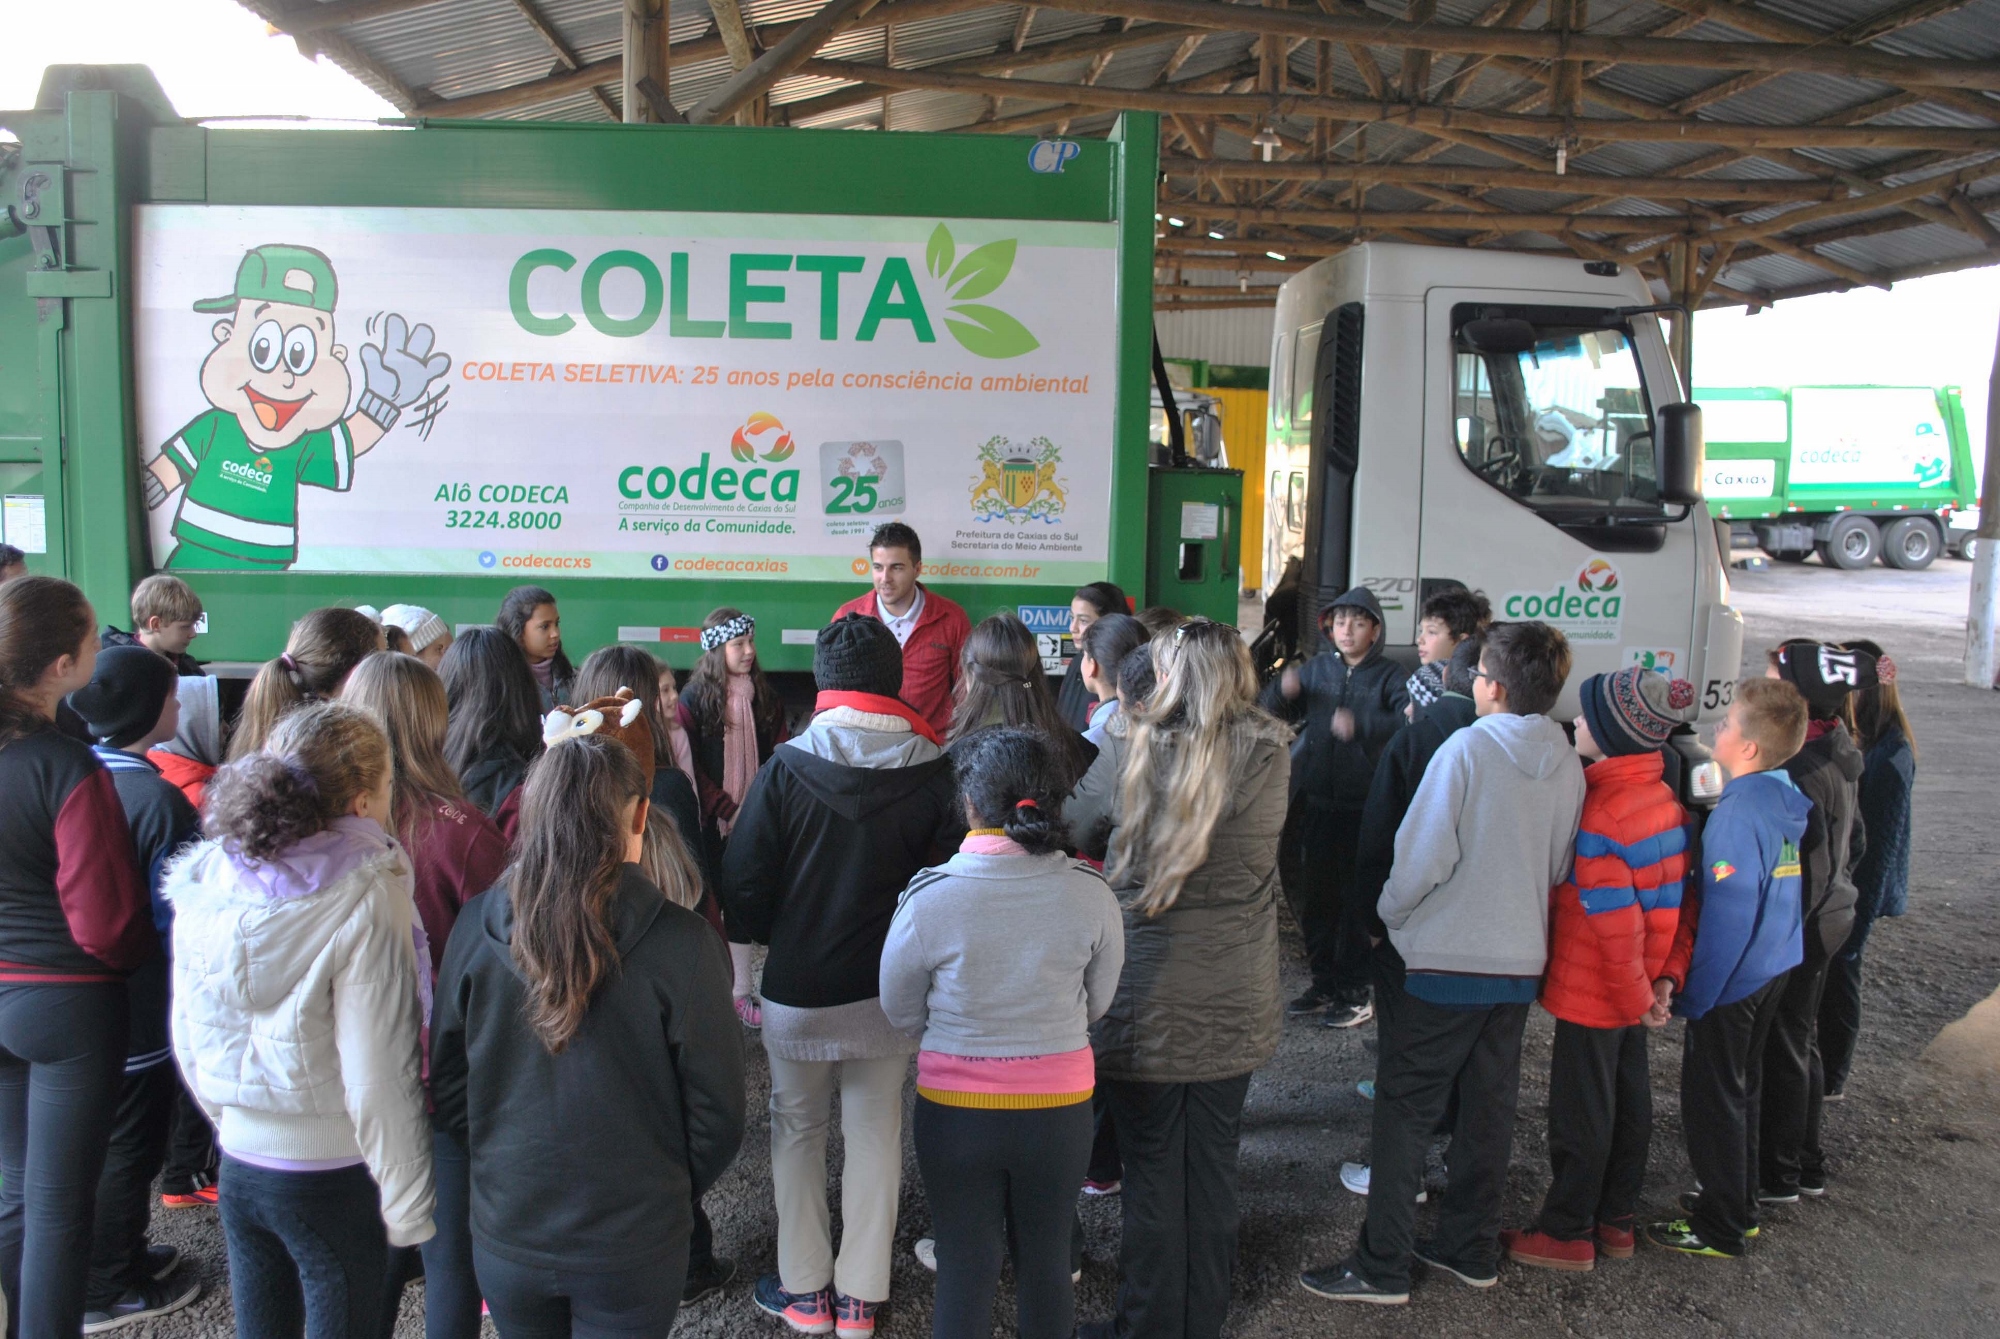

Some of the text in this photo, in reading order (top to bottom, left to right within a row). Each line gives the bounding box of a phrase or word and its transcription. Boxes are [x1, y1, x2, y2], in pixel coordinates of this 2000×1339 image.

[509, 248, 936, 343] COLETA
[462, 361, 1089, 394] COLETA SELETIVA: 25 anos pela consciência ambiental
[1800, 448, 1861, 463] codeca
[222, 459, 272, 485] codeca
[618, 452, 800, 502] codeca
[1715, 473, 1767, 485] Caxias
[434, 483, 569, 504] Alô CODECA
[825, 475, 904, 514] 25 anos
[618, 501, 796, 513] Companhia de Desenvolvimento de Caxias do Sul
[445, 510, 562, 530] 3224.8000
[618, 517, 796, 535] A serviço da Comunidade.
[956, 530, 1078, 541] Prefeitura de Caxias do Sul
[951, 540, 1082, 552] Secretaria do Meio Ambiente
[502, 554, 592, 569] codecacxs
[674, 557, 788, 573] codecacaxias
[1361, 577, 1415, 593] 270
[1505, 586, 1621, 618] codeca
